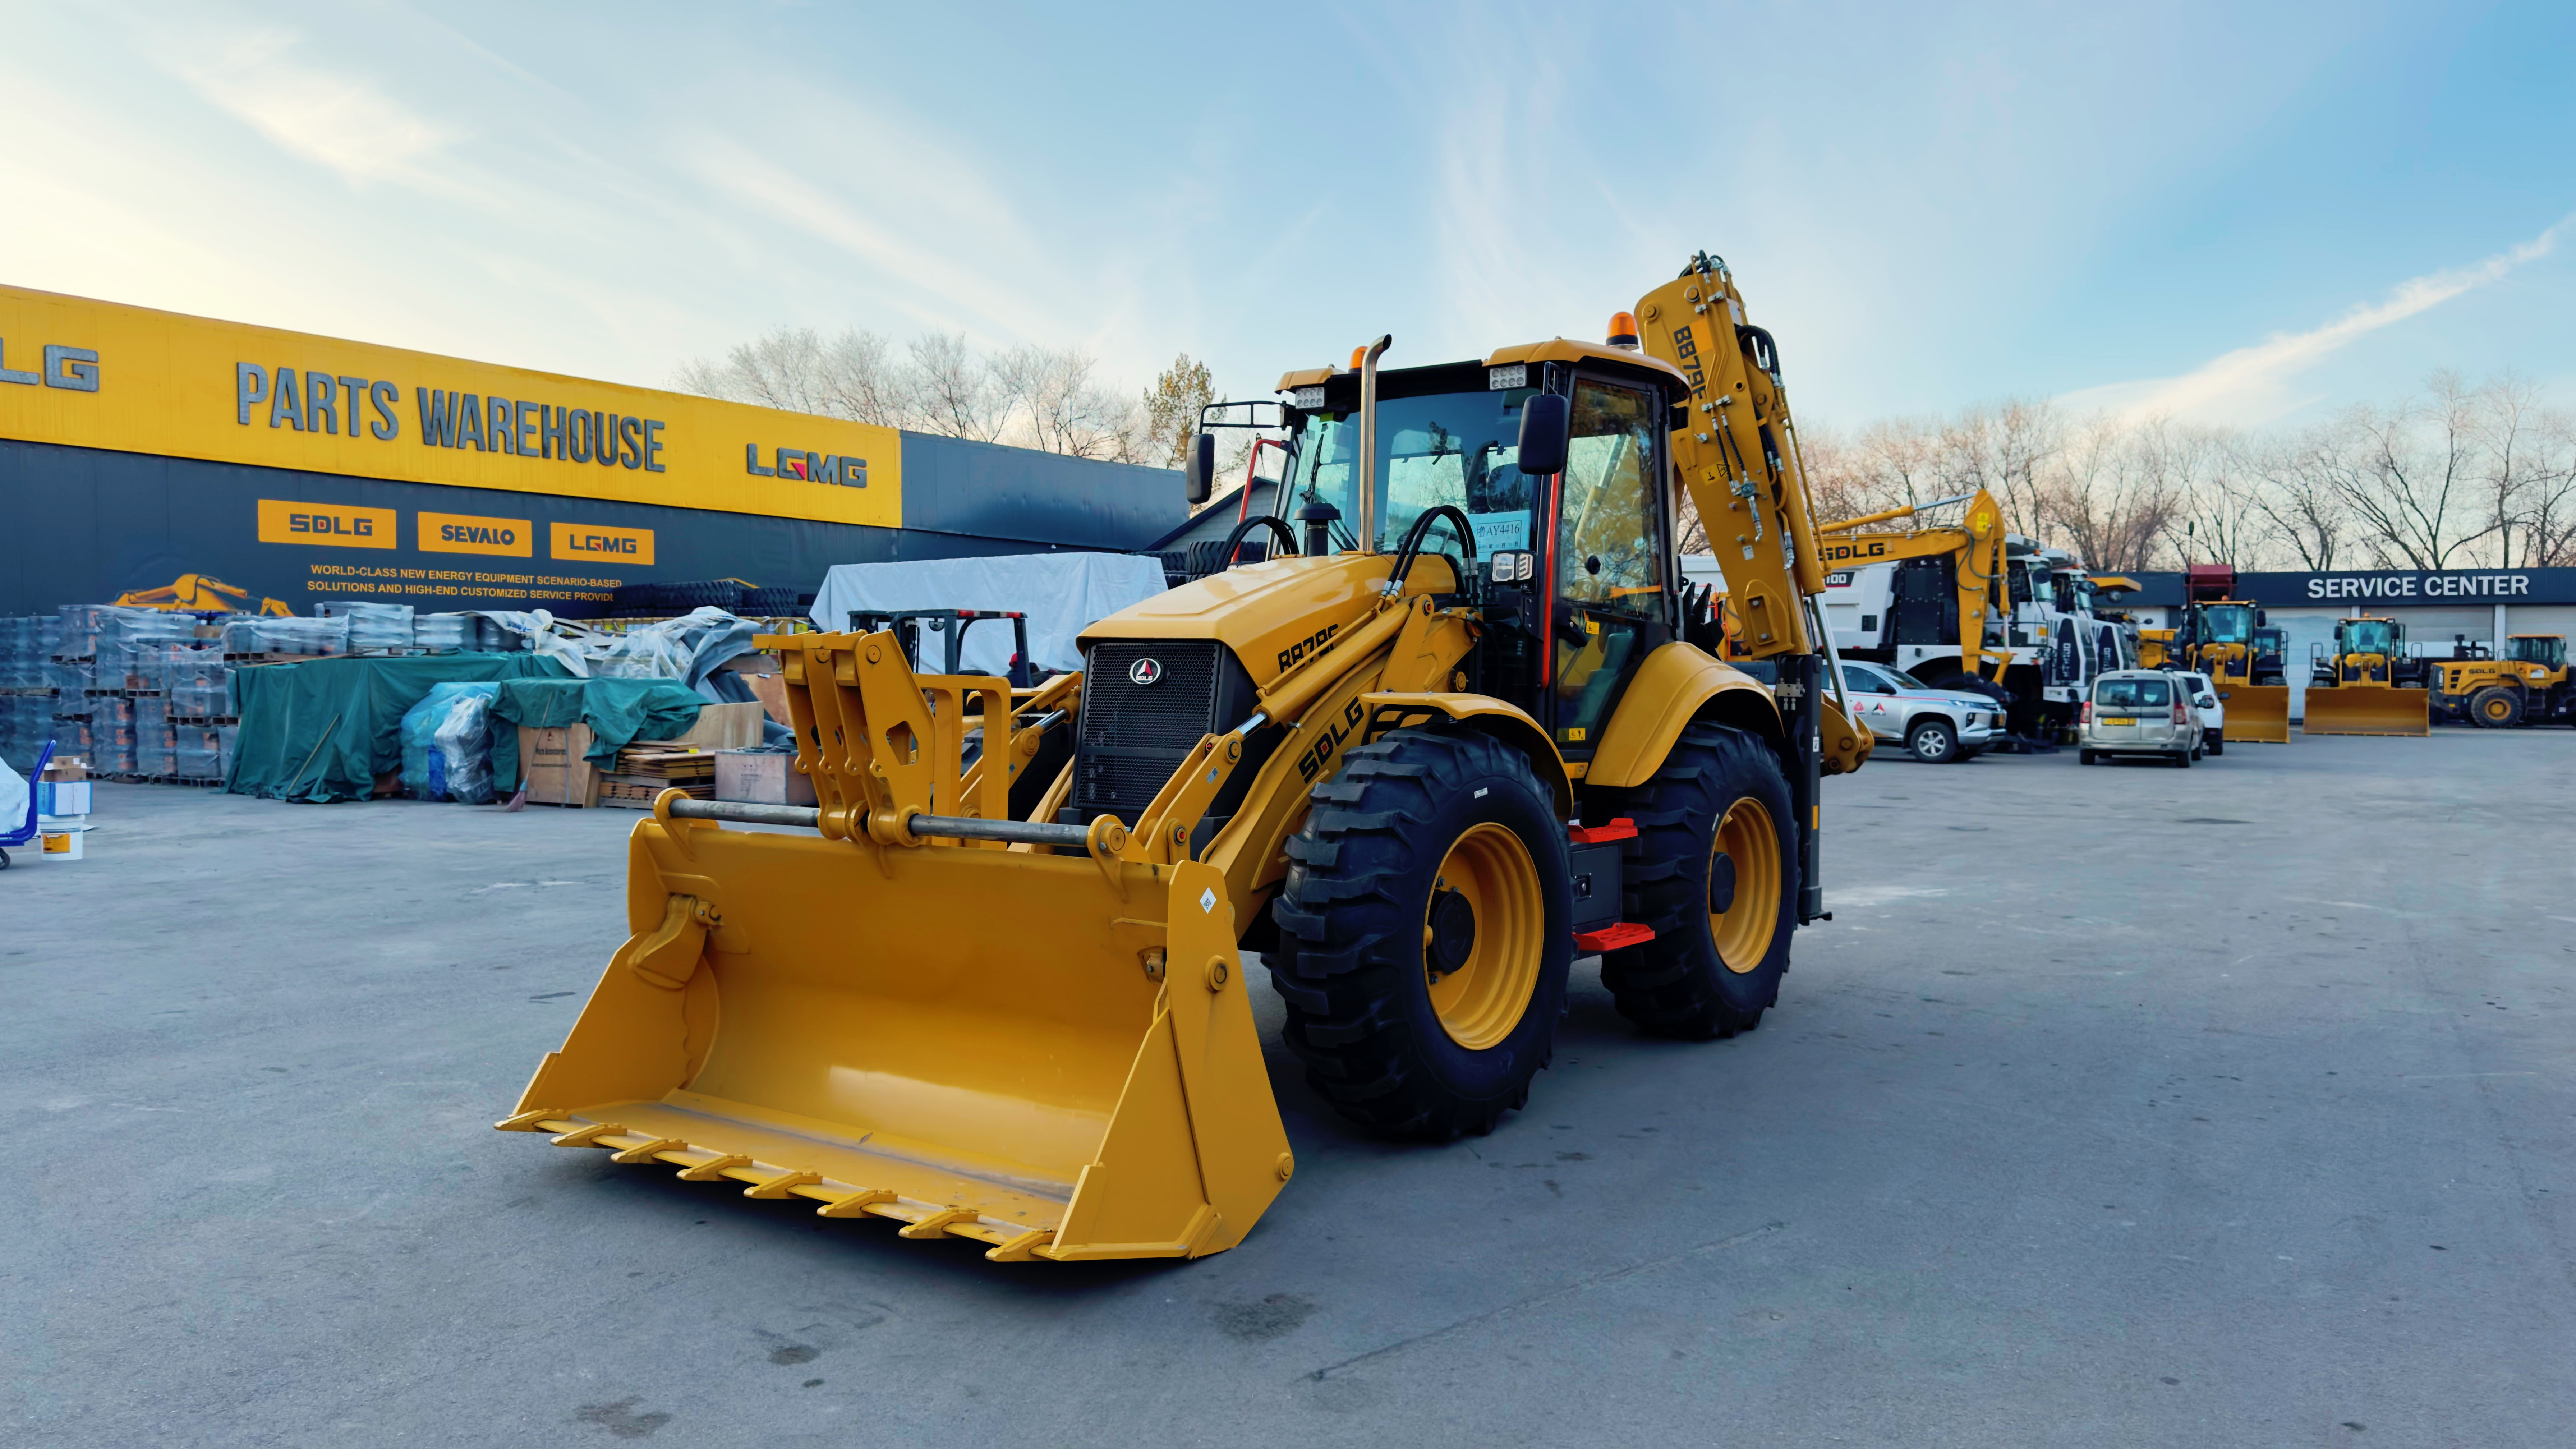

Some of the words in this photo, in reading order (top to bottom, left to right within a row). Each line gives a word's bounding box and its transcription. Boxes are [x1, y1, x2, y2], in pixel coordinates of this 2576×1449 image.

[237, 362, 399, 440] PARTS
[417, 387, 665, 472] WAREHOUSE
[747, 443, 867, 488] LGMG
[290, 514, 372, 536] SDLG
[441, 524, 515, 545] SEVALO
[570, 534, 637, 554] LGMG
[1818, 543, 1884, 561] SDLG
[311, 565, 397, 577] WORLD-CLASS
[400, 569, 426, 579] NEW
[429, 570, 472, 580] ENERGY
[475, 573, 534, 584] EQUIPMENT
[537, 576, 622, 587] SCENARIO-BASED
[2307, 576, 2417, 598] SERVICE
[2424, 575, 2529, 596] CENTER
[308, 581, 375, 592] SOLUTIONS
[378, 584, 402, 593] AND
[406, 585, 458, 595] HIGH-END
[461, 587, 527, 598] CUSTOMIZED
[530, 591, 571, 600] SERVICE
[1298, 696, 1364, 784] SDLG
